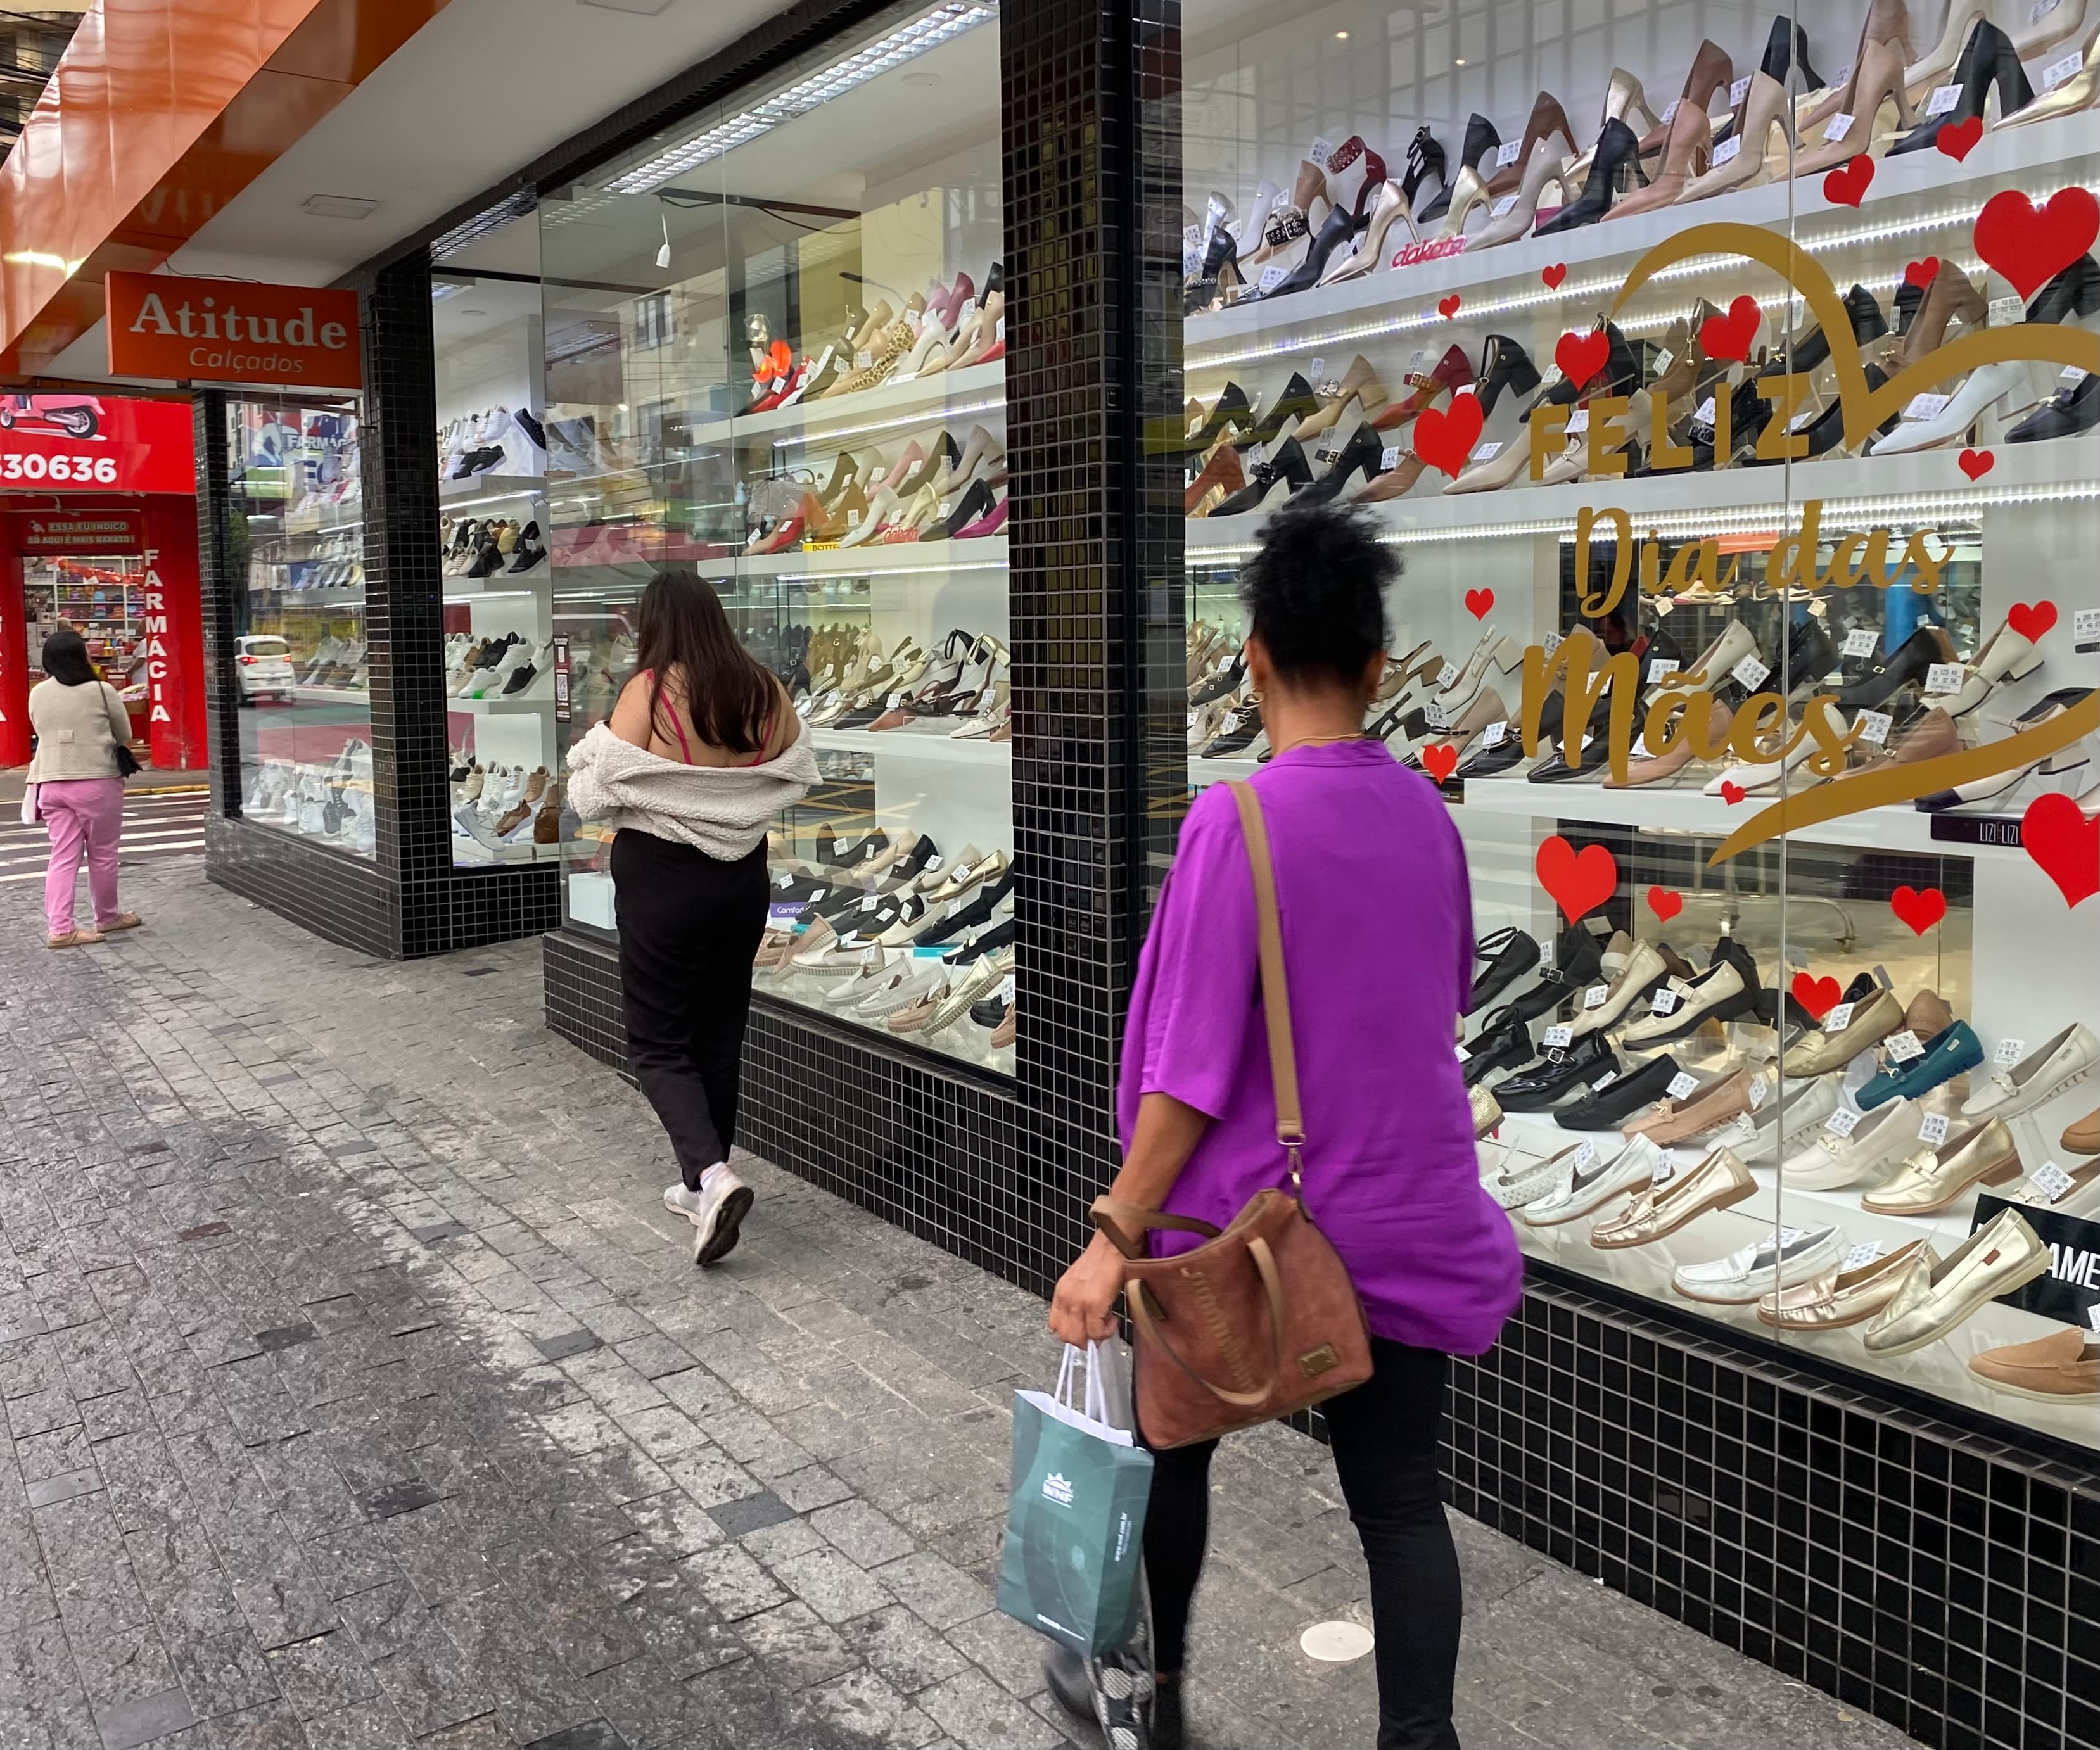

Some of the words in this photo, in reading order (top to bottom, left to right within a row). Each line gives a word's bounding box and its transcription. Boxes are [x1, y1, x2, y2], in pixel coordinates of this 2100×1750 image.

[129, 293, 347, 349] Atitude
[190, 347, 303, 374] Calçados
[1530, 372, 1812, 481] FELIZ
[0, 453, 117, 483] 30636
[49, 523, 75, 531] ESSA
[1575, 507, 1741, 618] Dia
[1765, 500, 1956, 595] das
[144, 548, 171, 722] FARMÁCIA
[1522, 633, 1868, 785] Mães
